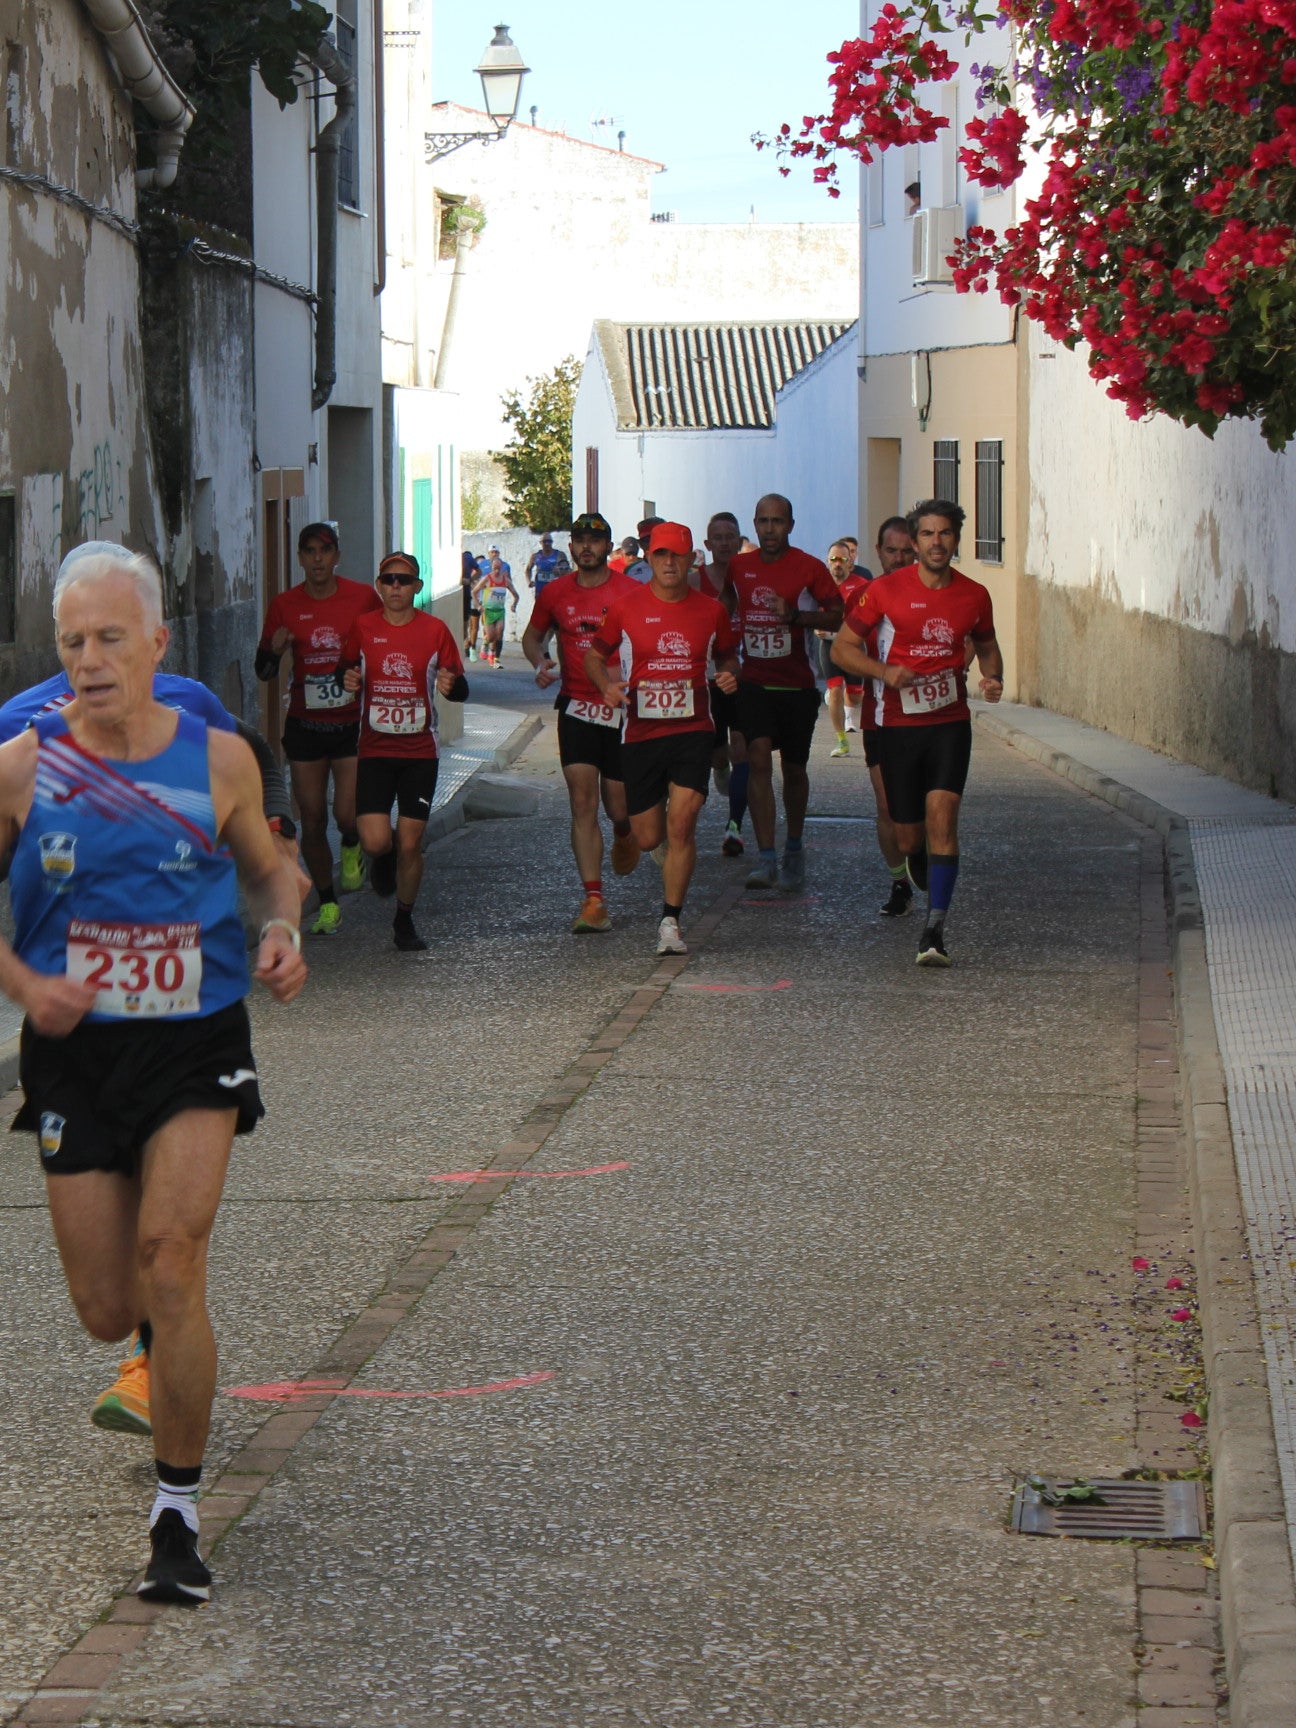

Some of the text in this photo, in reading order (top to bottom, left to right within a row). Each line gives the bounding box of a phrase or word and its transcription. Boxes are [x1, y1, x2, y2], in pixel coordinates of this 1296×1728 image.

[749, 634, 785, 650] 215
[316, 683, 344, 700] 30
[644, 690, 687, 709] 202
[908, 680, 951, 705] 198
[376, 706, 417, 725] 201
[573, 701, 614, 722] 209
[83, 949, 185, 993] 230
